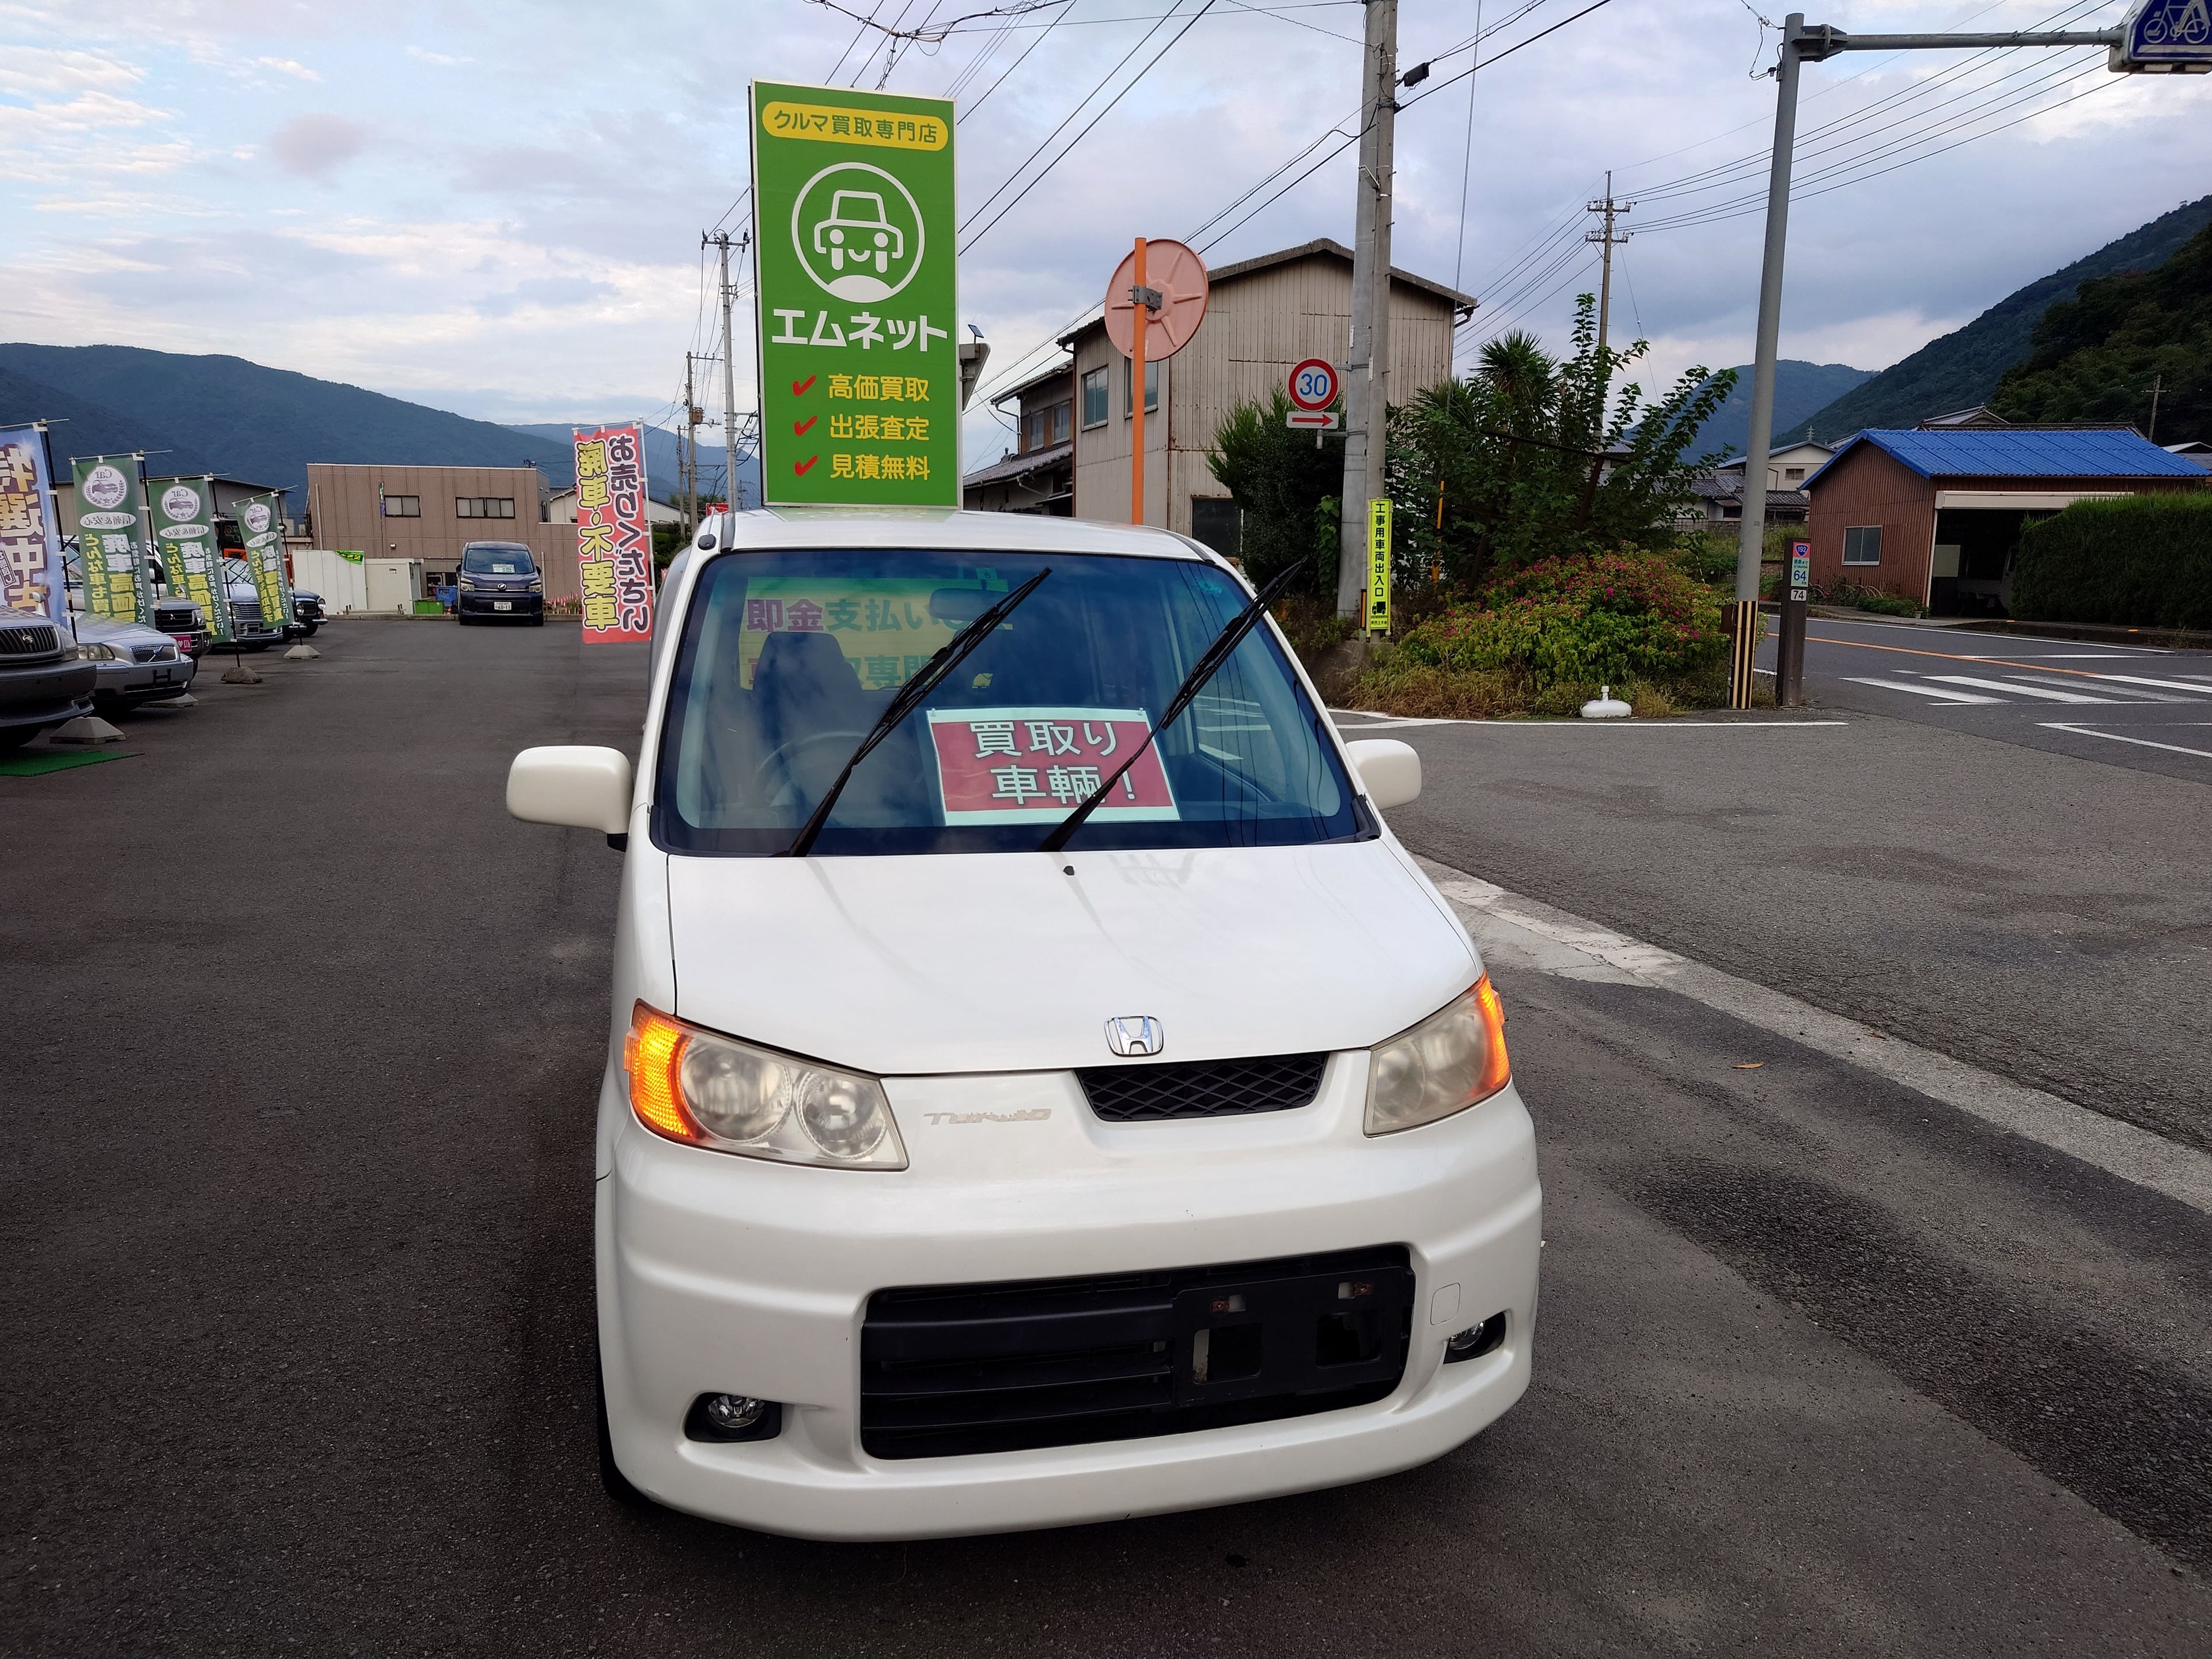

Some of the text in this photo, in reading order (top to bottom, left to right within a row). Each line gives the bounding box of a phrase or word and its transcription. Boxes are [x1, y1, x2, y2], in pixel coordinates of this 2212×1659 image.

[774, 110, 938, 143] クルマ買取専門店
[772, 308, 948, 352] エムネット
[828, 373, 930, 402] 高価買取
[1300, 373, 1328, 397] 30
[830, 414, 930, 441] 出張査定
[830, 454, 930, 480] 見積無料
[1374, 503, 1386, 597] 工事用車両出入口
[1794, 570, 1806, 581] 64
[1793, 590, 1804, 600] 74
[969, 721, 1117, 759] 買取り
